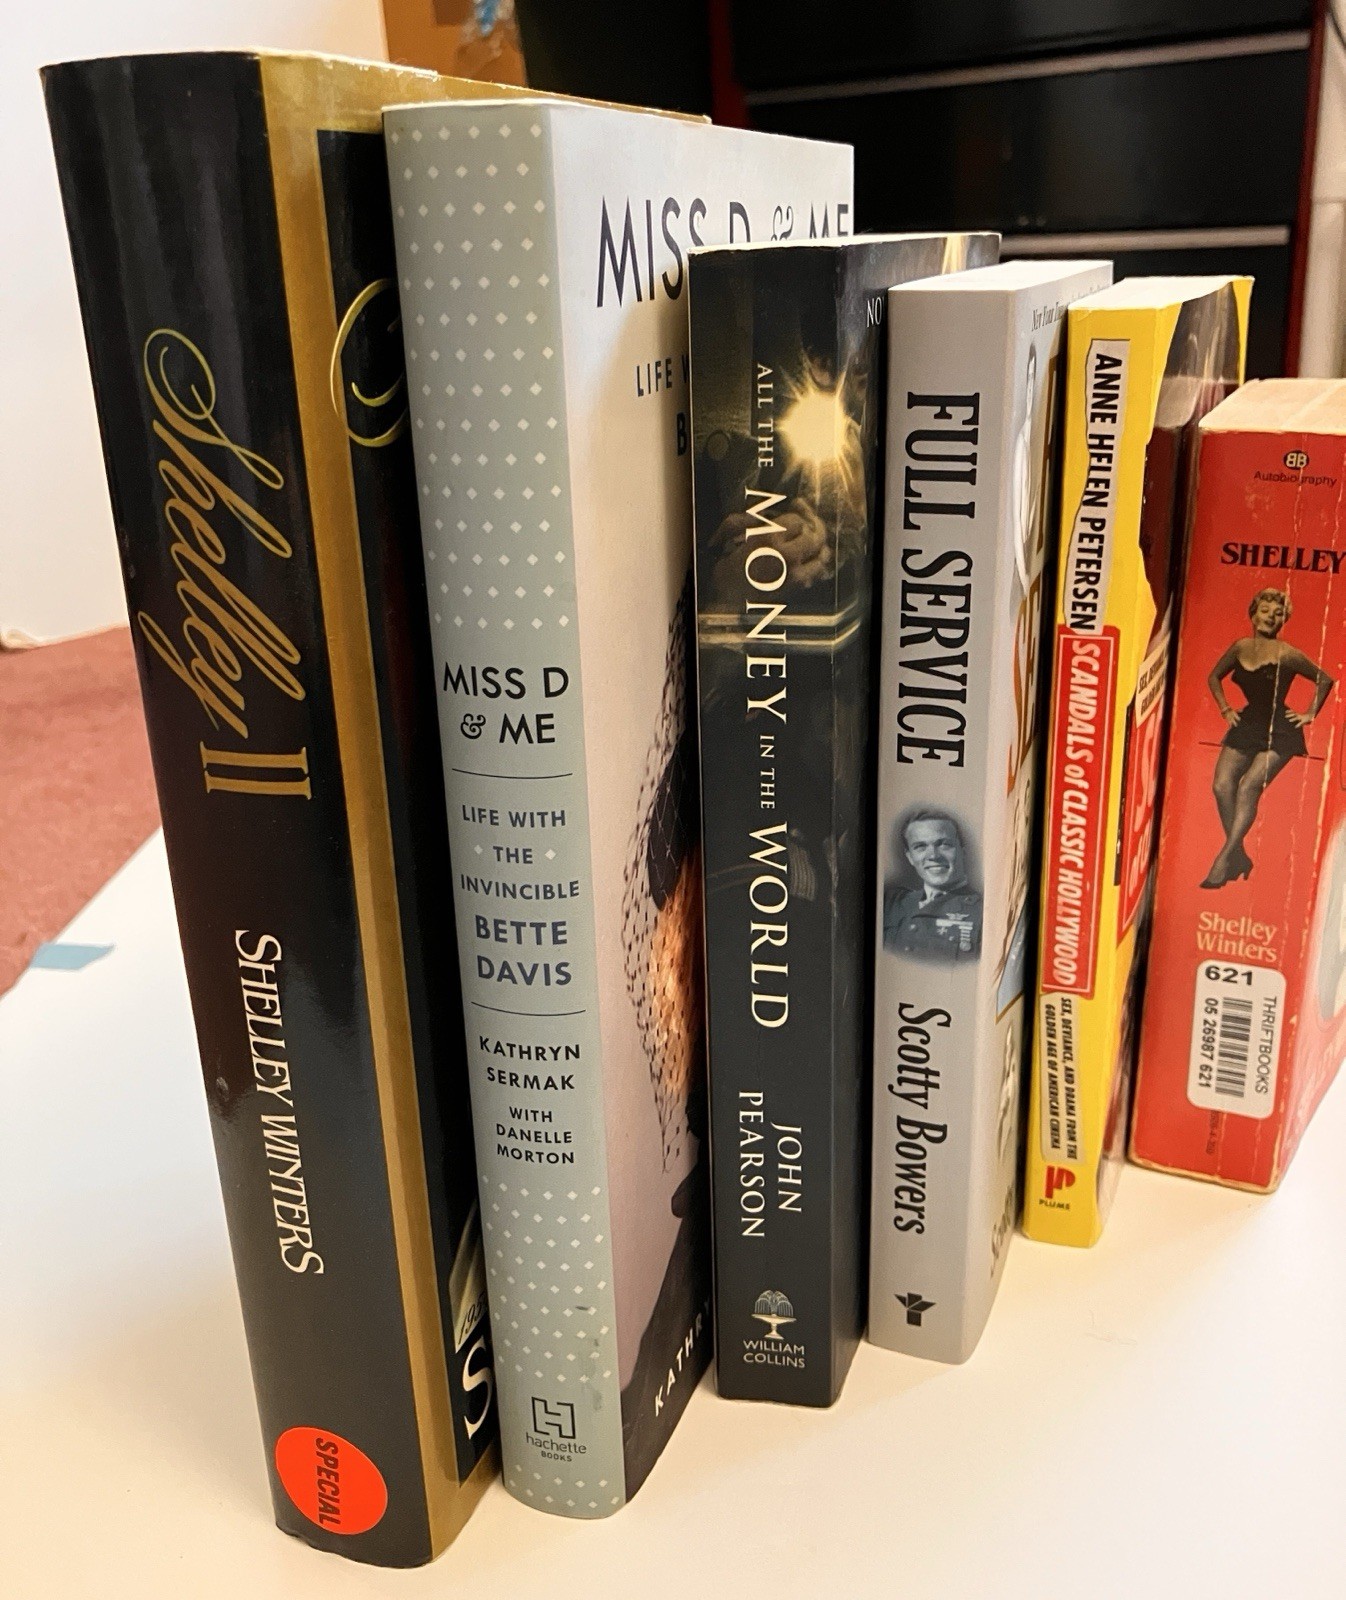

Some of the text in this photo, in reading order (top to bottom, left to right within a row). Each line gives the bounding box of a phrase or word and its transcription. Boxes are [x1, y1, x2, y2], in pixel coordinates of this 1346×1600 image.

[867, 296, 885, 328] NO
[637, 358, 673, 397] LIFE
[1069, 353, 1122, 631] ANNE HELEN PETERSEN
[1254, 470, 1337, 487] Autobiography
[138, 329, 312, 799] Shelley II
[1221, 542, 1346, 574] SHELLEY
[897, 391, 980, 768] FULL SERVICE
[443, 662, 569, 699] MISS D
[745, 363, 789, 1028] ALL THE MONEY IN THE WORLD
[461, 713, 555, 744] & ME
[462, 804, 566, 828] LIFE WITH
[1053, 640, 1100, 987] SCANDALS of CLASSIC HOLLYWOOD
[493, 845, 533, 864] THE
[461, 874, 580, 900] INVINCIBLE
[475, 915, 568, 945] BETTE
[1198, 911, 1277, 945] Shelley
[1196, 931, 1277, 963] Winters
[477, 955, 572, 986] DAVIS
[1205, 965, 1253, 985] 621
[1204, 998, 1218, 1014] 05
[479, 1036, 580, 1060] KATHRYN
[1255, 996, 1277, 1094] THRIFTBOOKS
[487, 1067, 575, 1090] SERMAK
[1045, 1004, 1061, 1149] GOLDEN AGE OF AMERICAN CINEMA
[1064, 1066, 1075, 1084] AND
[1198, 1064, 1213, 1088] 621
[235, 930, 324, 1275] SHELLEY WINTERS
[509, 1106, 552, 1123] WITH
[1065, 1086, 1076, 1116] DRAMA
[496, 1123, 572, 1144] DANELLE
[887, 1002, 952, 1235] Scotty Bowers
[1066, 1118, 1077, 1141] FROM
[497, 1144, 574, 1164] MORTON
[739, 1091, 765, 1237] PEARSON
[771, 1121, 802, 1212] JOHN
[1067, 1144, 1078, 1160] THE
[1039, 1198, 1070, 1210] PLUME
[655, 1301, 709, 1417] KATHR
[743, 1340, 805, 1355] WILLIAM
[743, 1353, 805, 1369] COLLINS
[526, 1432, 587, 1454] hachette
[541, 1451, 572, 1462] BOOKS
[314, 1438, 339, 1524] SPECIAL
